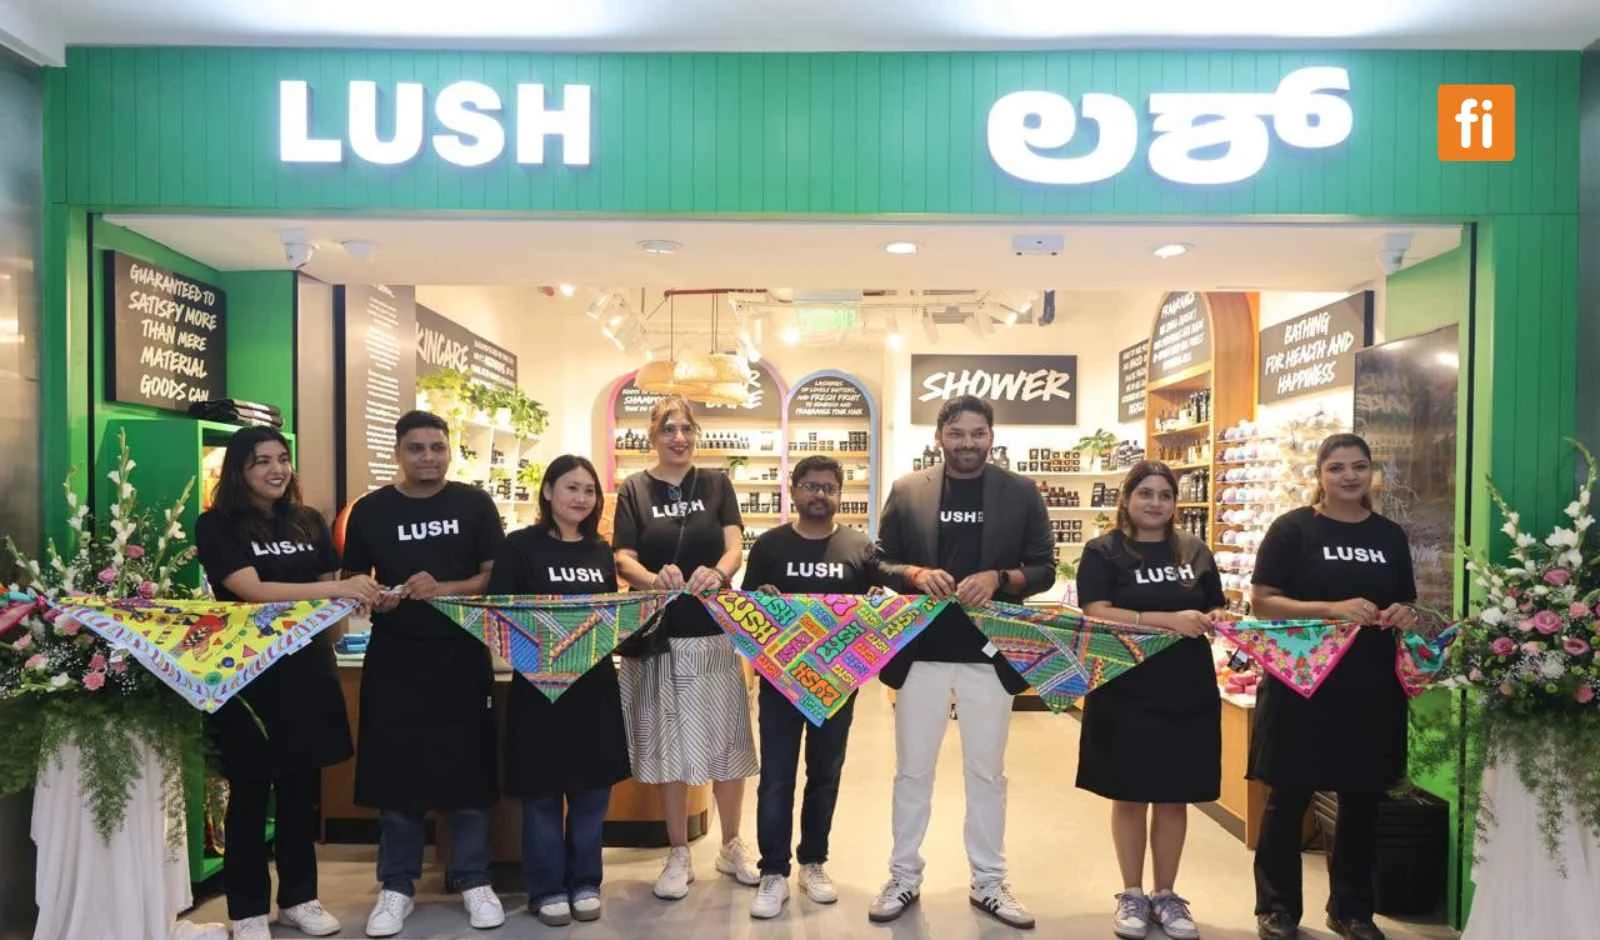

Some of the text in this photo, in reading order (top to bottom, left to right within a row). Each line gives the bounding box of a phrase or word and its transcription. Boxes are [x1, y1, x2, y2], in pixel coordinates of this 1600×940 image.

[280, 80, 591, 166] LUSH
[987, 66, 1354, 185] ಲಶ್
[130, 264, 215, 306] GUARANTEED TO
[128, 292, 217, 331] SATISFY MORE
[142, 319, 207, 351] THAN MERE
[1284, 312, 1331, 345] BATHING
[140, 346, 208, 378] MATERIAL
[416, 321, 469, 373] KINCARE
[1265, 331, 1354, 376] FOR HEALTH AND
[140, 374, 210, 402] GOODS CAN
[918, 368, 1071, 402] SHOWER
[1277, 361, 1337, 394] HAPPINESS
[397, 519, 459, 541] LUSH
[940, 511, 976, 523] USH
[786, 562, 844, 578] LUSH
[1323, 546, 1387, 563] LUSH
[548, 566, 604, 583] LUSH
[1134, 563, 1195, 584] LUSH
[716, 592, 778, 646] LUSH
[815, 620, 866, 664] LUSH
[789, 661, 842, 708] LUSH
